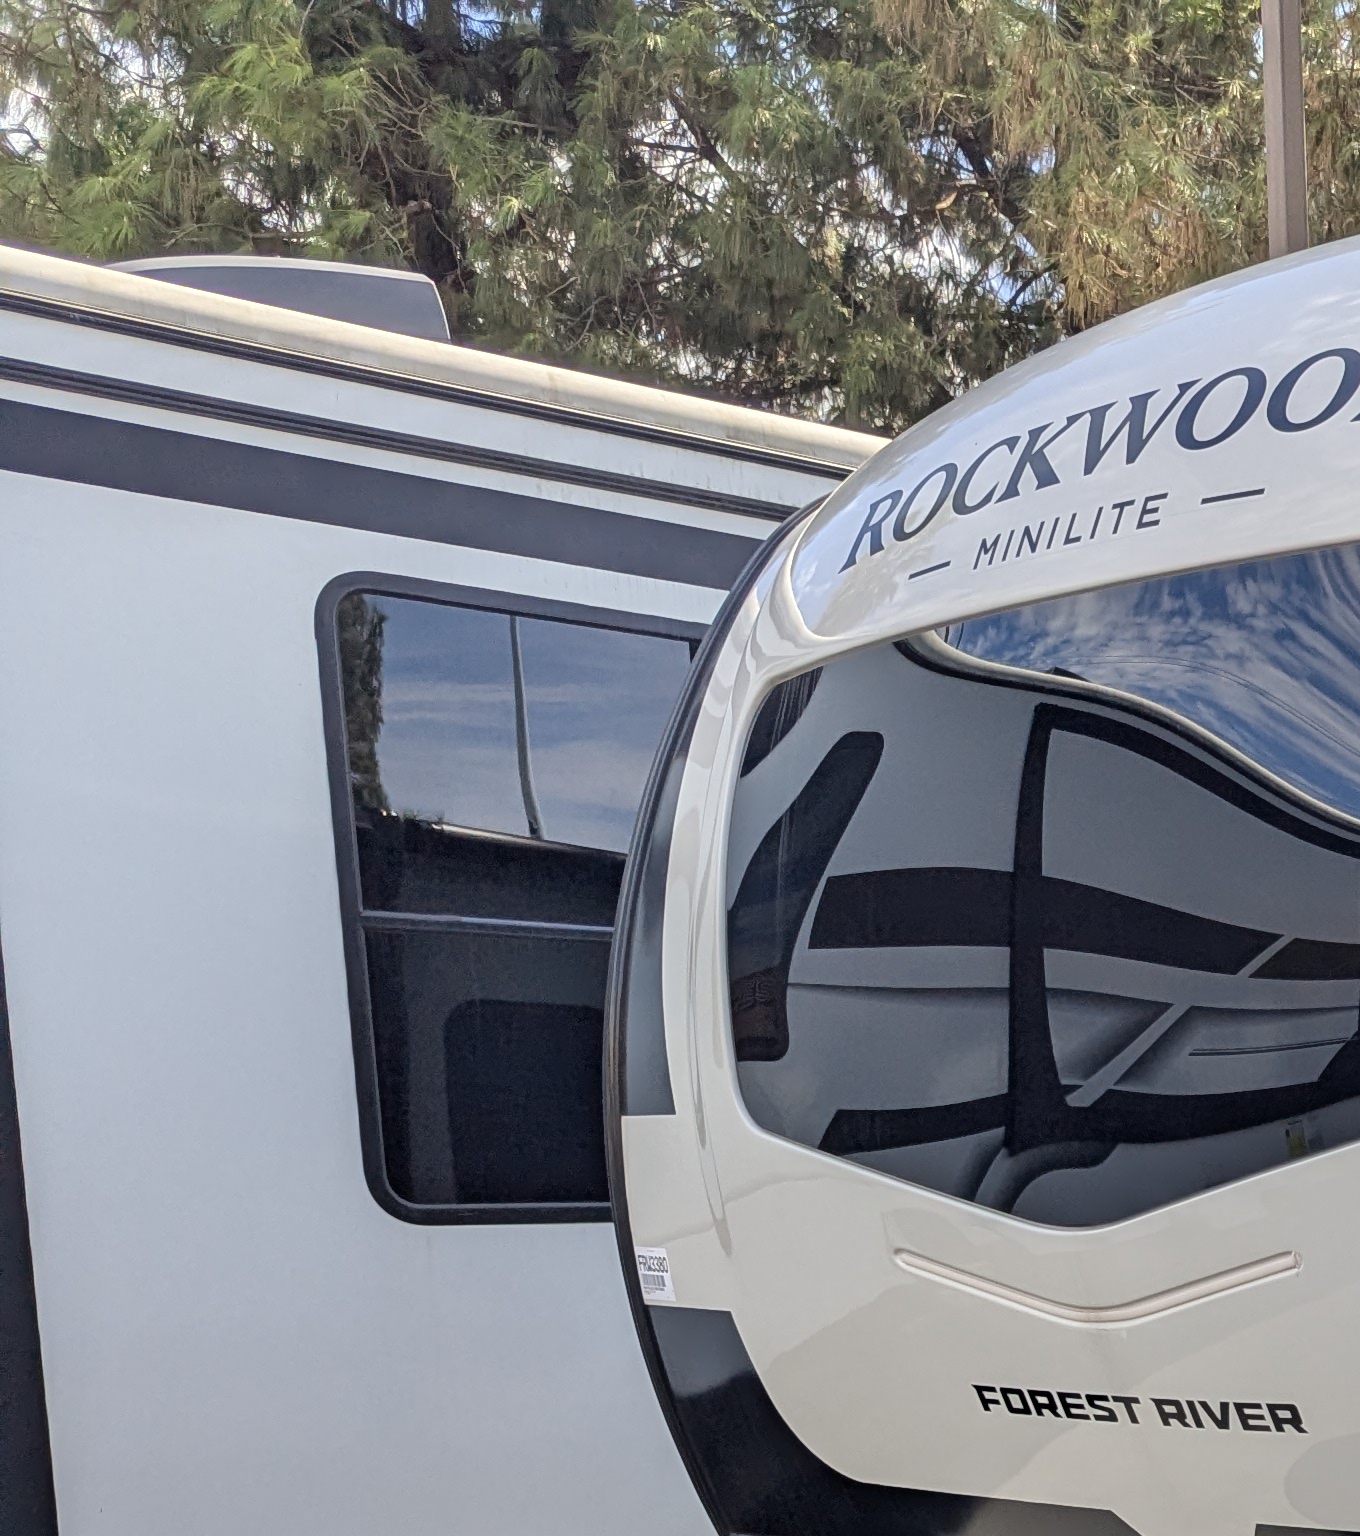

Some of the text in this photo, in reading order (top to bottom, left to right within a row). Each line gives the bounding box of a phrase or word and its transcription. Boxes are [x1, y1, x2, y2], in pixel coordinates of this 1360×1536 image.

[973, 492, 1170, 570] MINILITE
[971, 1384, 1309, 1434] FOREST RIVER
